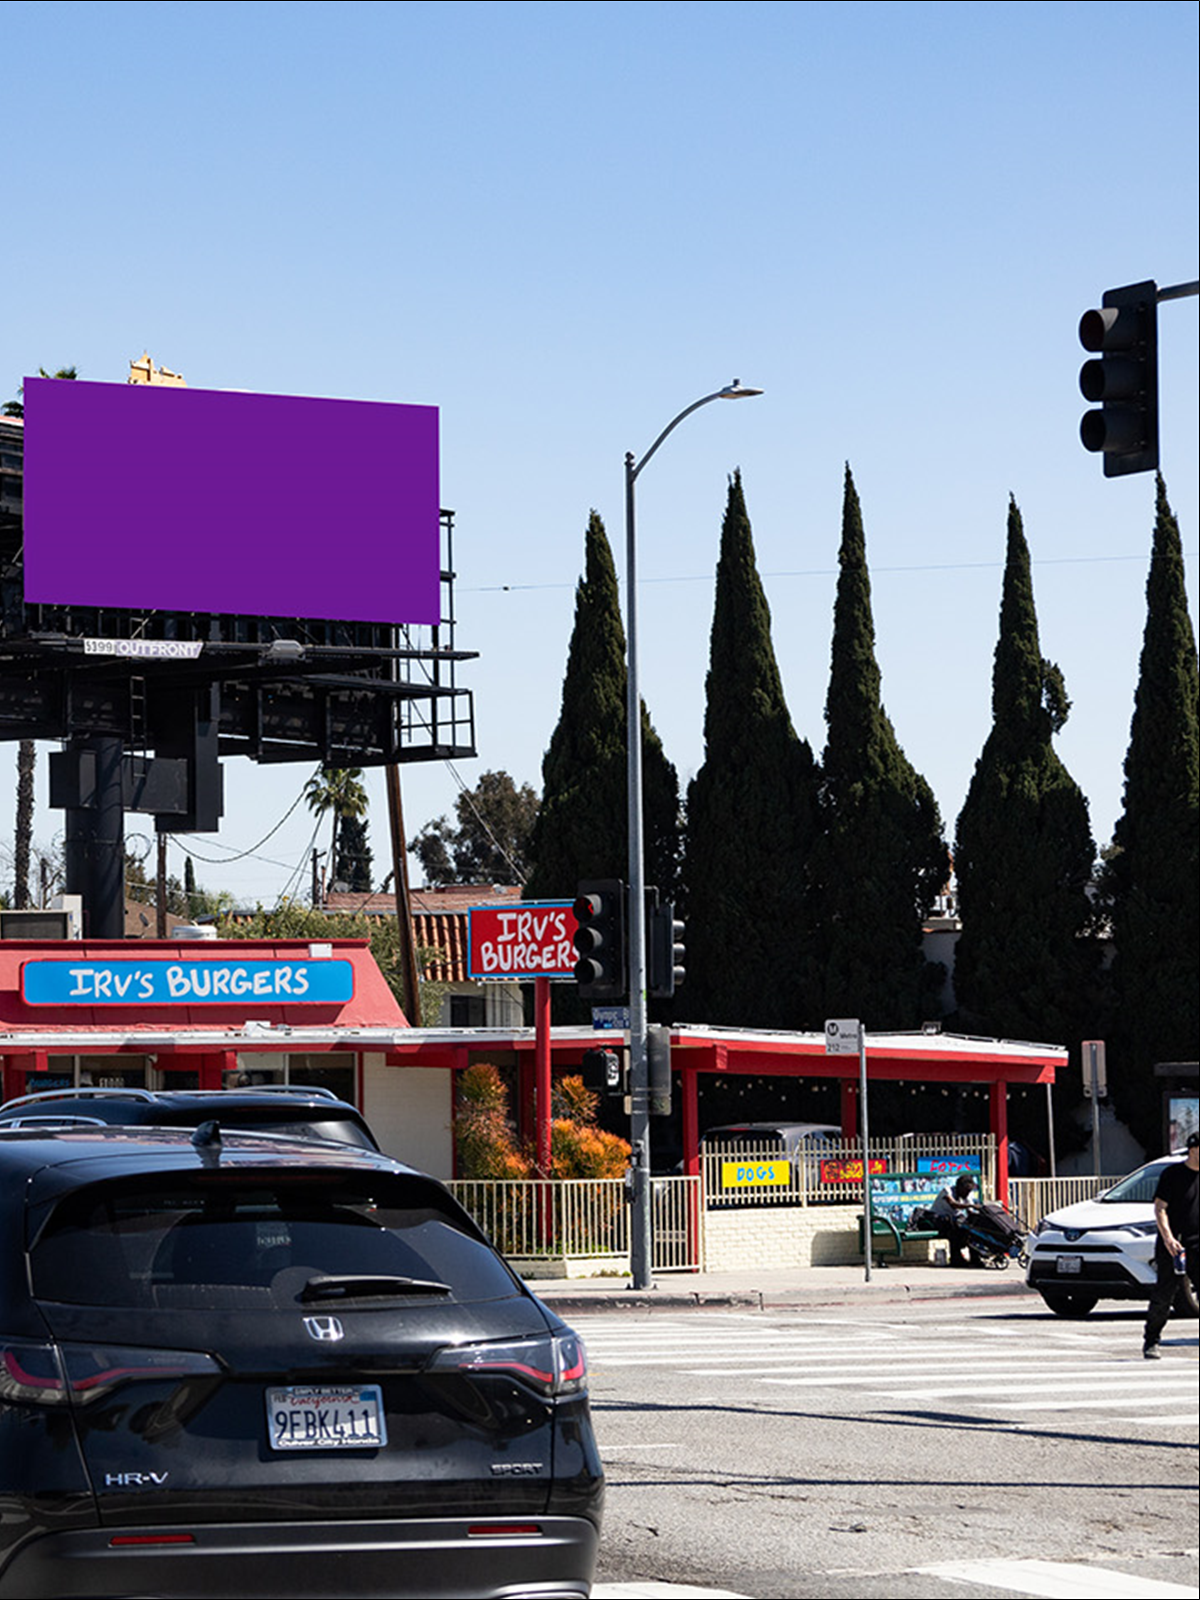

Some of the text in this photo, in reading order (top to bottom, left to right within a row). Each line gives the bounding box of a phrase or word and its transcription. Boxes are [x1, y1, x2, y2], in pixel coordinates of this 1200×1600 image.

[119, 642, 201, 657] OUTFRONT
[497, 911, 566, 942] IRV'S
[481, 941, 580, 972] BURGERS
[69, 965, 309, 998] IRV'S BURGERS
[737, 1166, 775, 1182] DOGS
[275, 1409, 375, 1438] 9FBK411
[317, 1439, 340, 1447] City
[341, 1437, 380, 1445] Honda
[491, 1463, 543, 1475] SPORT
[105, 1471, 169, 1485] HR-V
